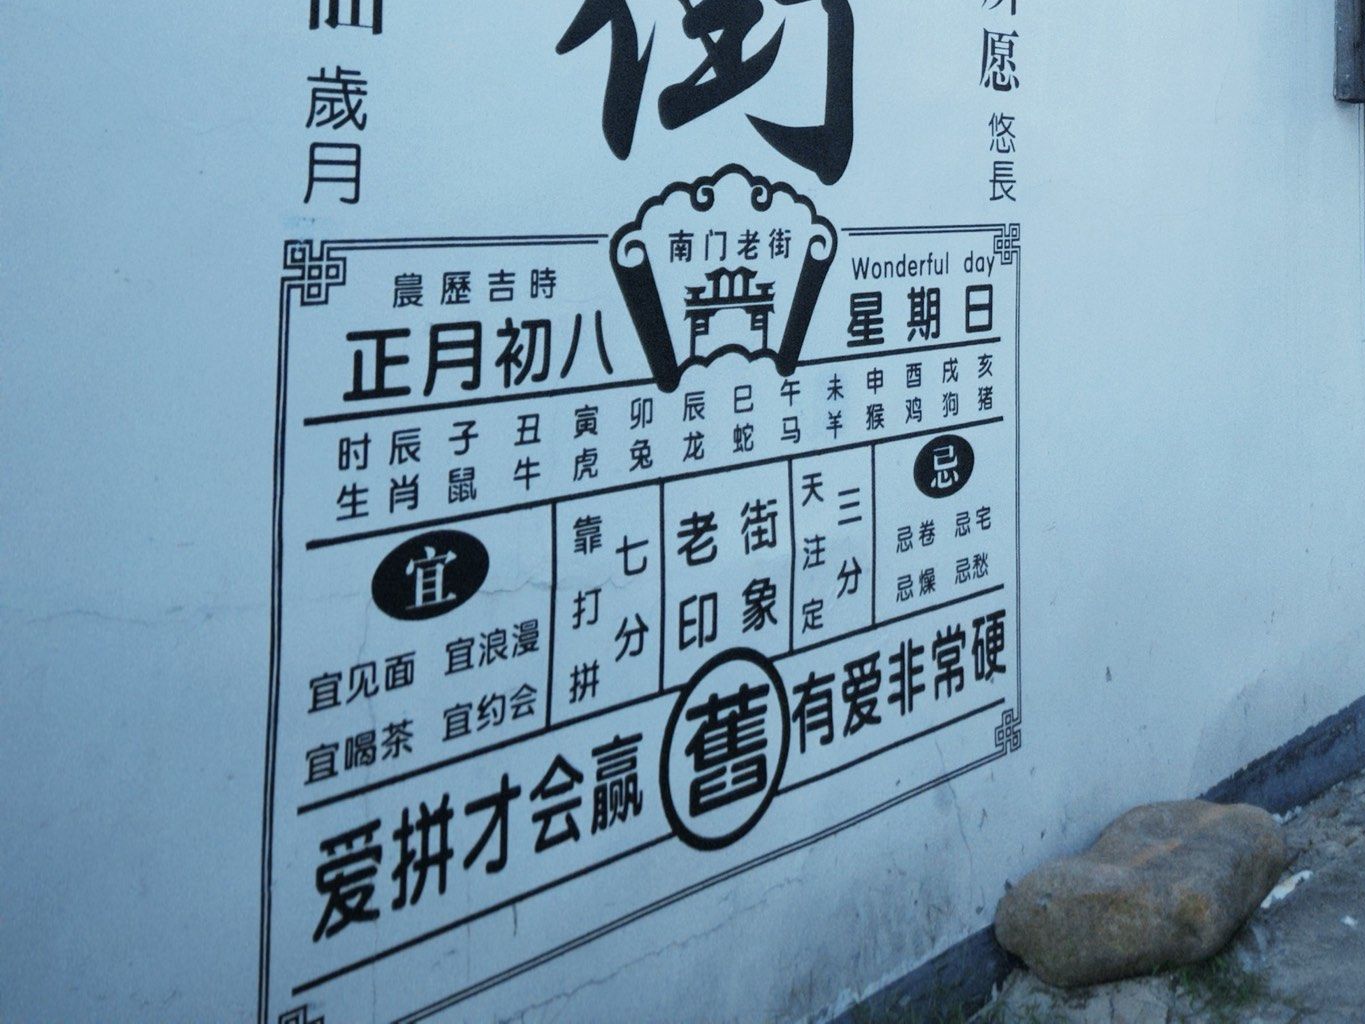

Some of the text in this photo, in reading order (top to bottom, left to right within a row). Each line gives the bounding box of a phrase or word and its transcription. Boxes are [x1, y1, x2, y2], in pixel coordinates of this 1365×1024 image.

[303, 65, 368, 205] 歲月
[668, 228, 791, 264] 南门老街
[852, 250, 996, 282] Wonderful day
[392, 267, 557, 309] 農歷吉時
[847, 284, 995, 349] 星期日
[342, 310, 613, 402] 正月初八
[930, 445, 959, 489] 忌
[955, 505, 991, 538] 忌宅
[404, 547, 457, 611] 宜
[307, 620, 540, 715] 宜见面 宜浪漫
[791, 608, 1008, 753] 有爱非常硬
[304, 683, 539, 785] 宜喝茶 宜约会
[686, 683, 770, 818] 舊
[312, 732, 644, 943] 爱拼才会赢
